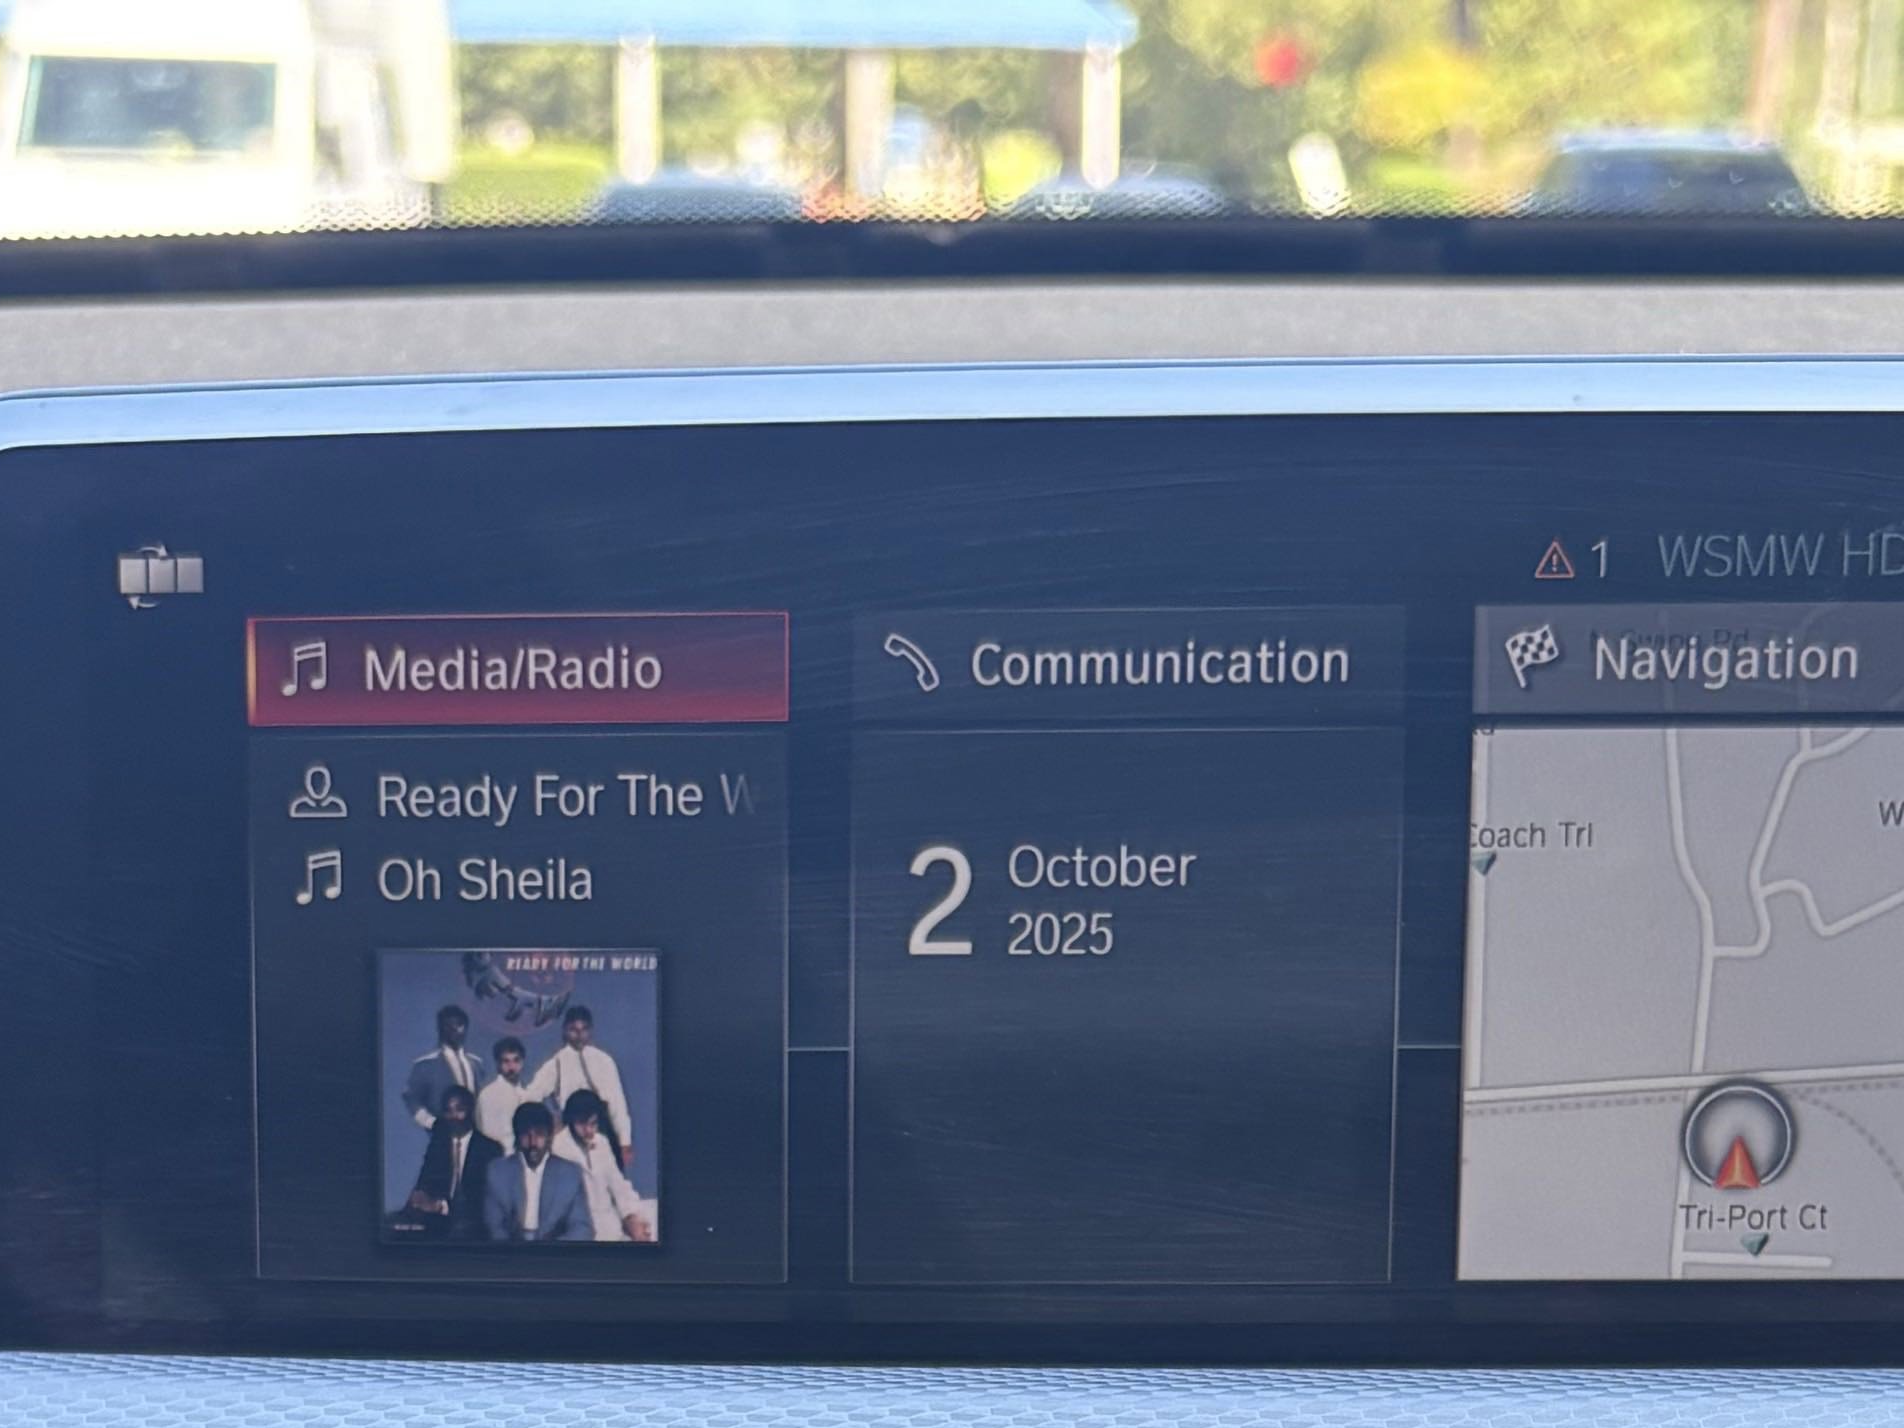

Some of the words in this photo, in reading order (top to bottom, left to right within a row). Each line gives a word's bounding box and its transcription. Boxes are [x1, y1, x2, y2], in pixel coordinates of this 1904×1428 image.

[1591, 540, 1607, 578] 1
[1658, 532, 1825, 577] WSMW
[365, 646, 662, 691] Media/Radio
[972, 640, 1348, 686] Communication
[1596, 636, 1858, 690] Navigation
[379, 775, 518, 827] Ready
[535, 774, 605, 817] For
[617, 773, 703, 816] The
[379, 858, 441, 901] Oh
[459, 858, 592, 901] Sheila
[1009, 844, 1197, 888] October
[907, 844, 974, 956] 2
[1008, 911, 1113, 955] 2025
[1679, 1204, 1788, 1231] Tri-Port
[1798, 1204, 1828, 1230] Ct
